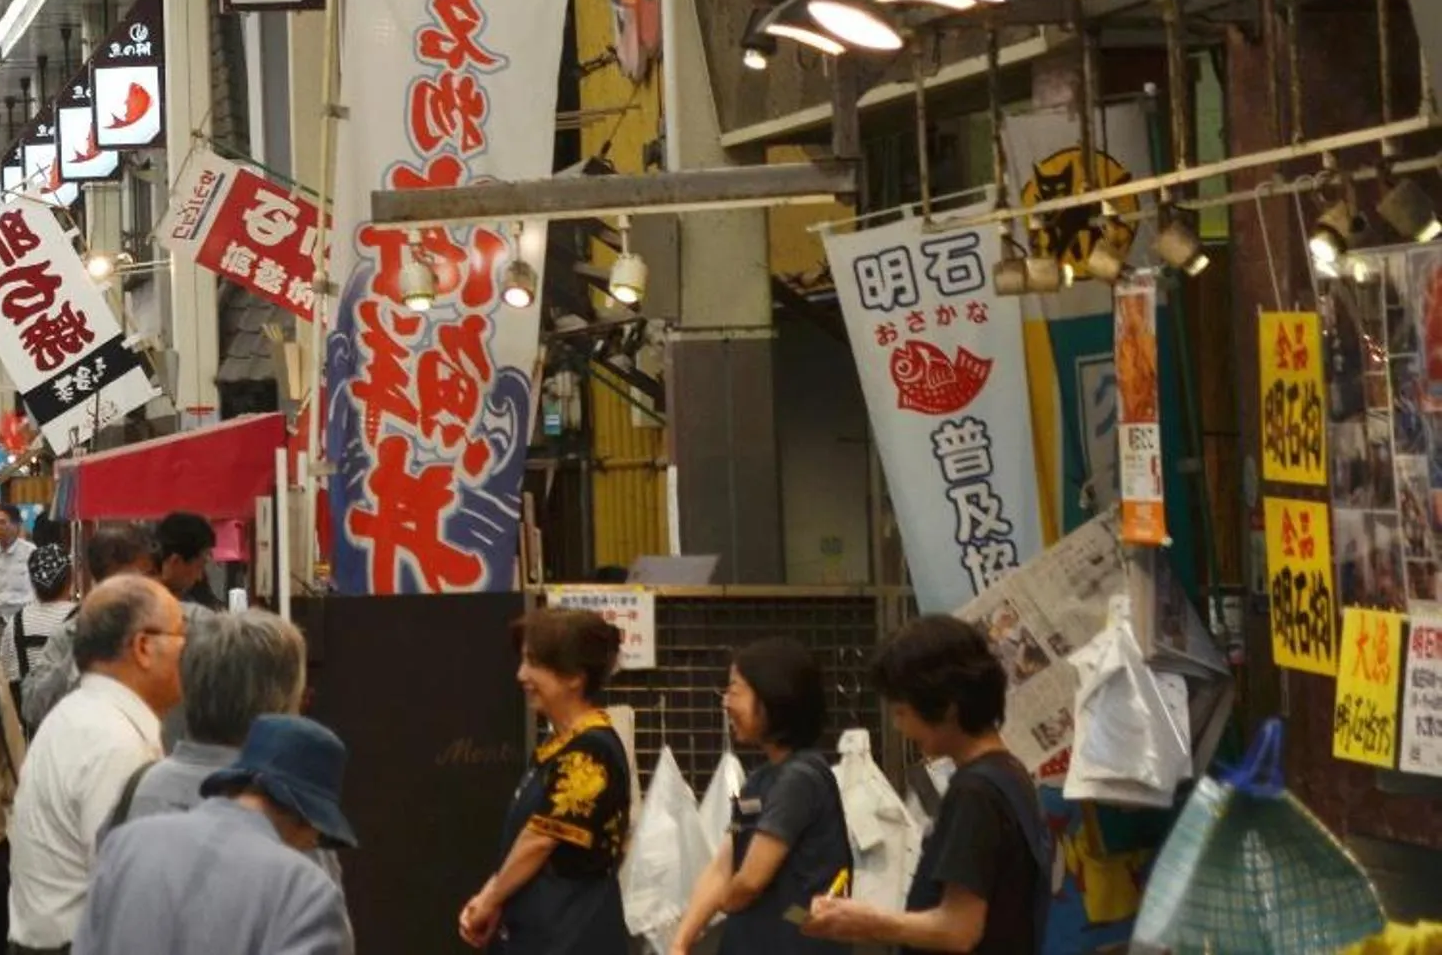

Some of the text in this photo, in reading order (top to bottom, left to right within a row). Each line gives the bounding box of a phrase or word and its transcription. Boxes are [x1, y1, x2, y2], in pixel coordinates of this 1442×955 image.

[853, 231, 986, 312] 明石
[874, 300, 989, 346] おさかな
